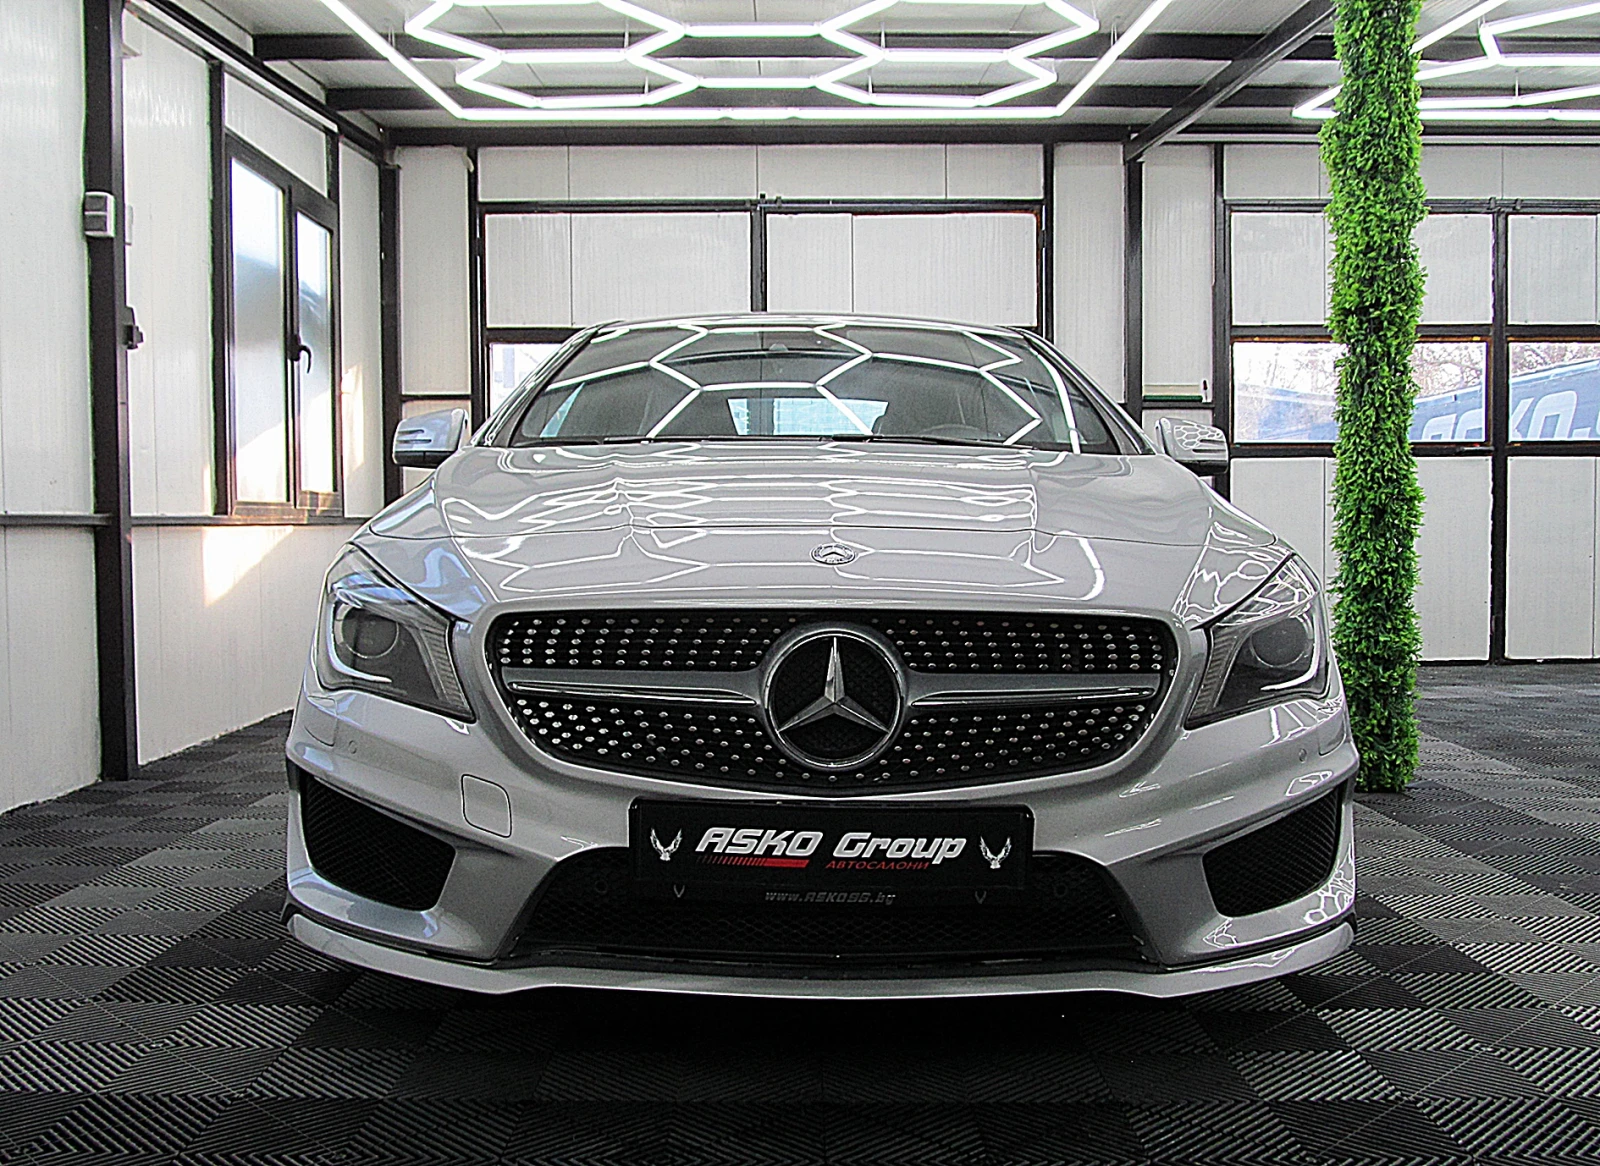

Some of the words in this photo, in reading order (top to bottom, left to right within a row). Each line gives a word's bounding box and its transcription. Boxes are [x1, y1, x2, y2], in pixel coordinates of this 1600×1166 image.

[695, 827, 824, 856] ASKO
[833, 832, 967, 865] Group
[825, 859, 930, 870] АВТОСАЛОНИ
